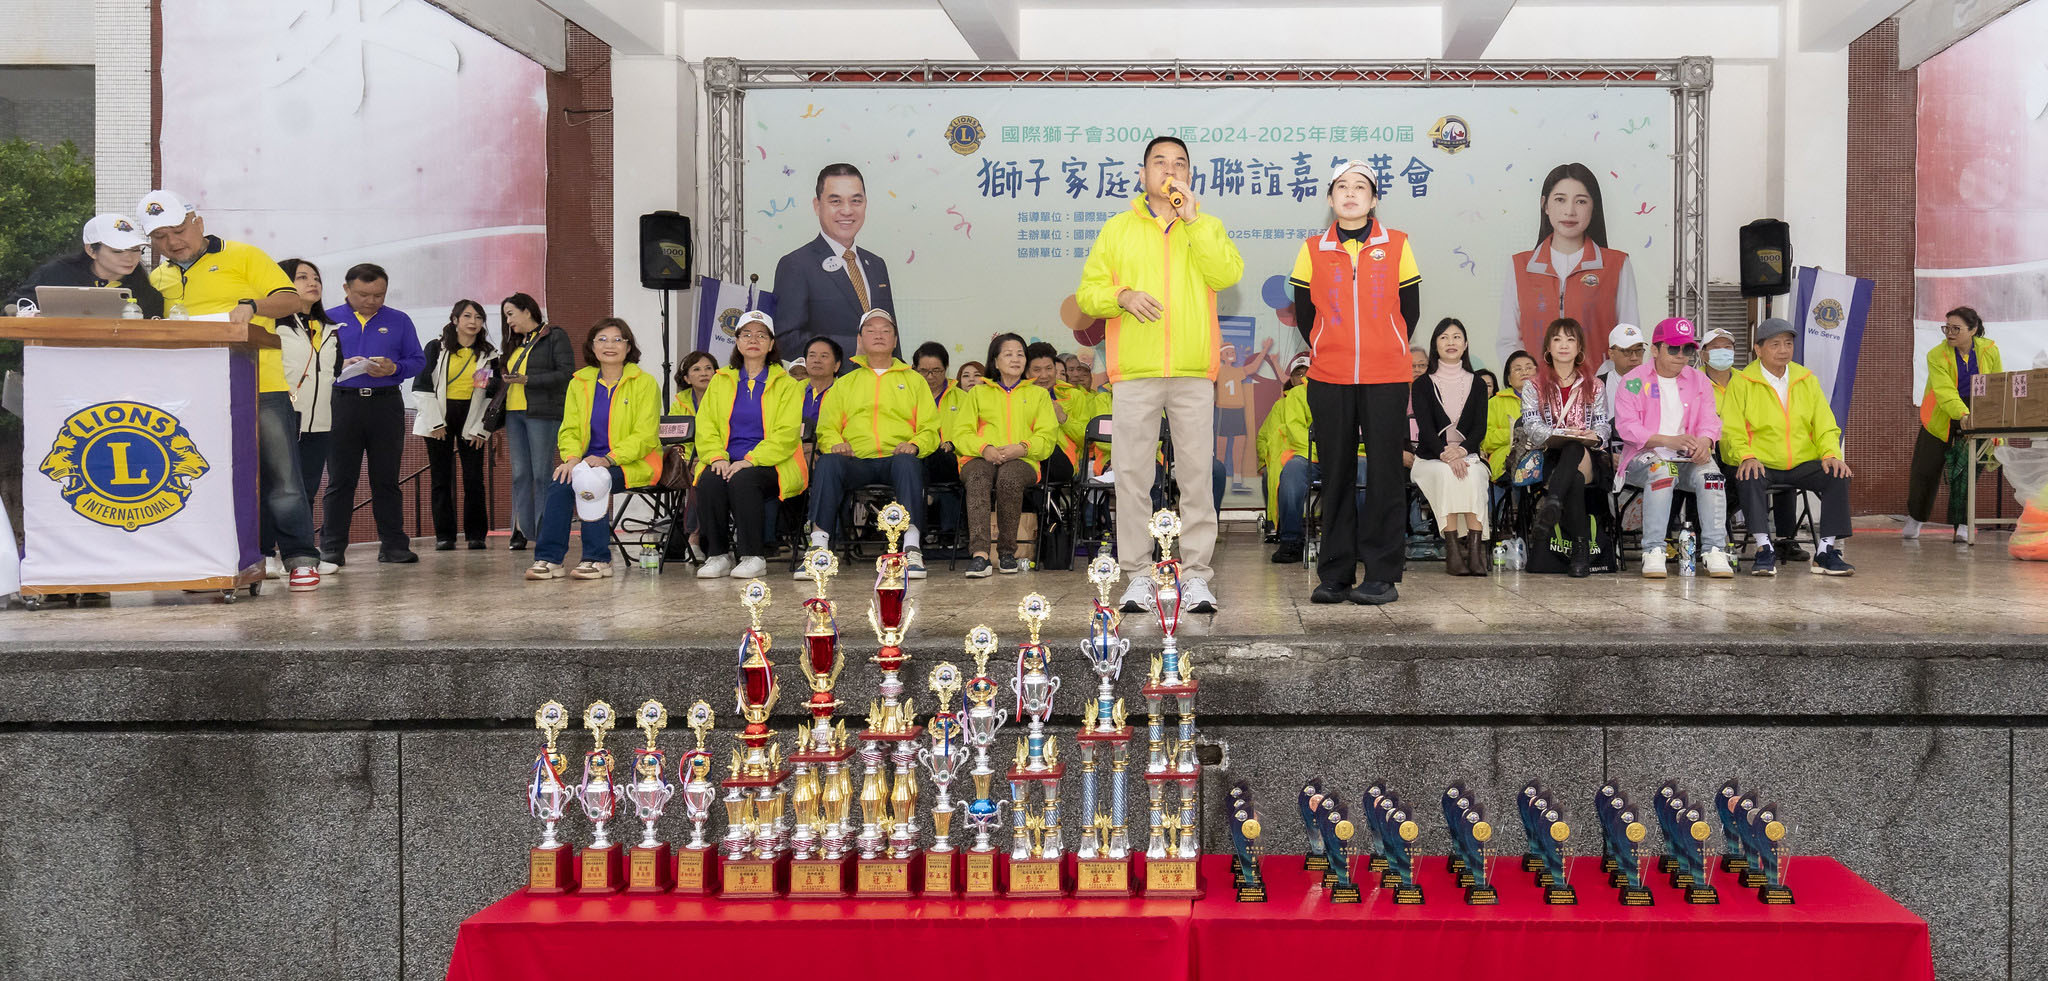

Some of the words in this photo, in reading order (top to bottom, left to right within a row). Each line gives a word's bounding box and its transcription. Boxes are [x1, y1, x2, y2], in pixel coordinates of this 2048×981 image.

[953, 117, 977, 125] LIONS
[1001, 125, 1414, 143] 國際獅子會300A2區2024-2025年度第40屆
[1821, 331, 1840, 341] Serve
[1225, 380, 1235, 395] 1
[74, 406, 170, 434] LIONS
[107, 442, 150, 485] L
[82, 497, 175, 520] INTERNATIONAL
